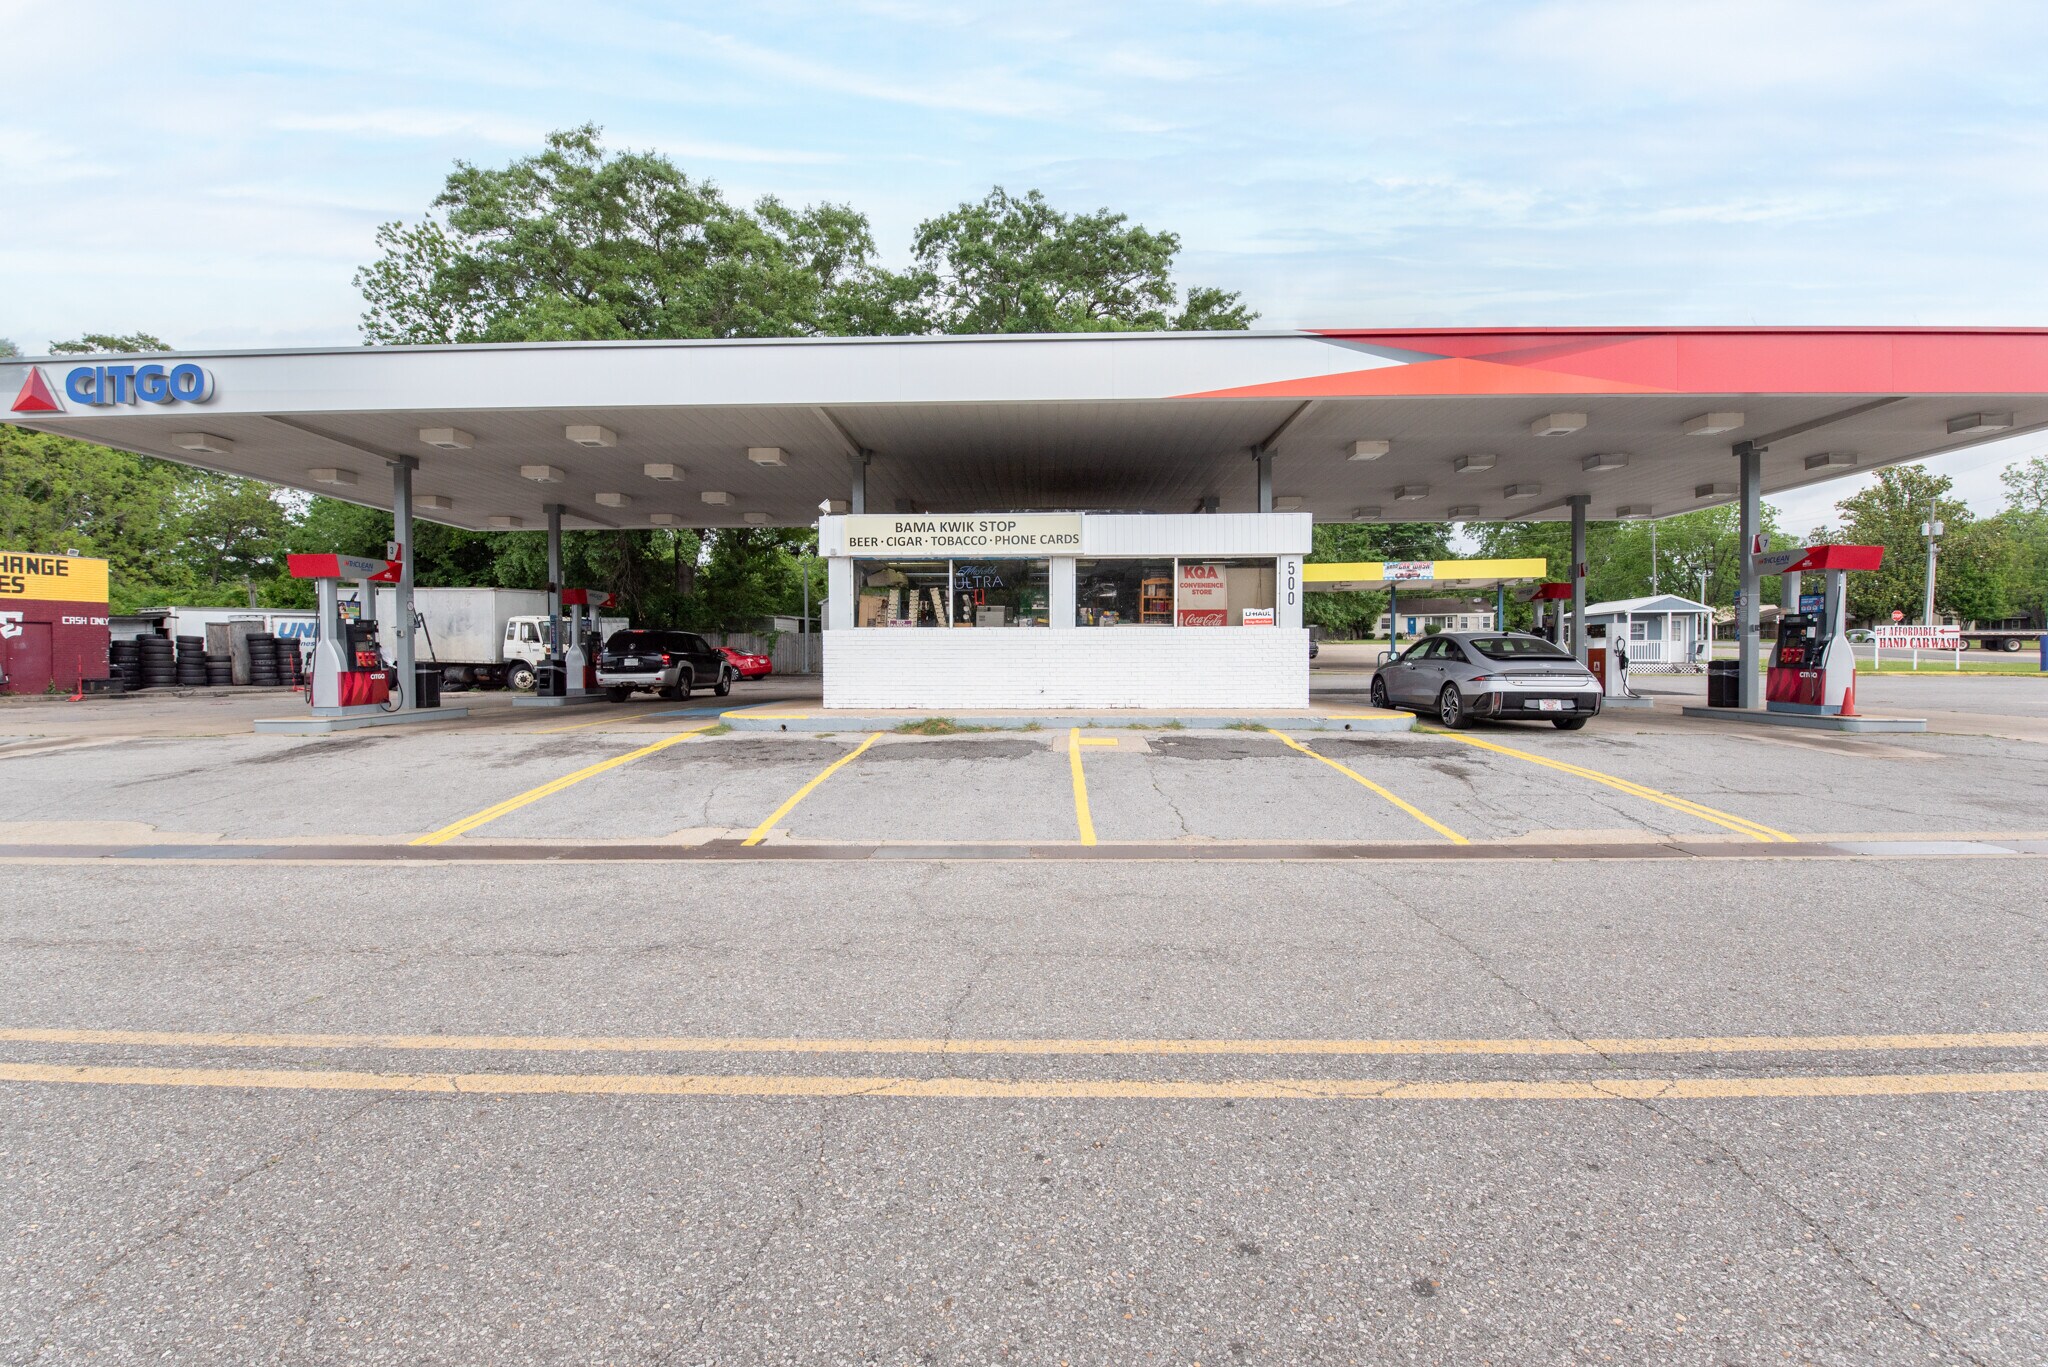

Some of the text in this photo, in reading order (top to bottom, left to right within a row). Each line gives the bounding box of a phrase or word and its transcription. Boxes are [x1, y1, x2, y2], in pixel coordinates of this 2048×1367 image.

[65, 363, 207, 405] CITGO
[895, 521, 1017, 533] BAMA KWIK STOP
[850, 534, 1080, 547] BEER CIGAR TOBACCO PHONE CARDS
[1184, 566, 1218, 579] KQA
[954, 575, 1003, 589] ULTRA
[61, 616, 110, 626] CASH ONLY
[1889, 626, 1937, 637] AFFORDABLE
[1879, 637, 1959, 649] HAND CAR WASH
